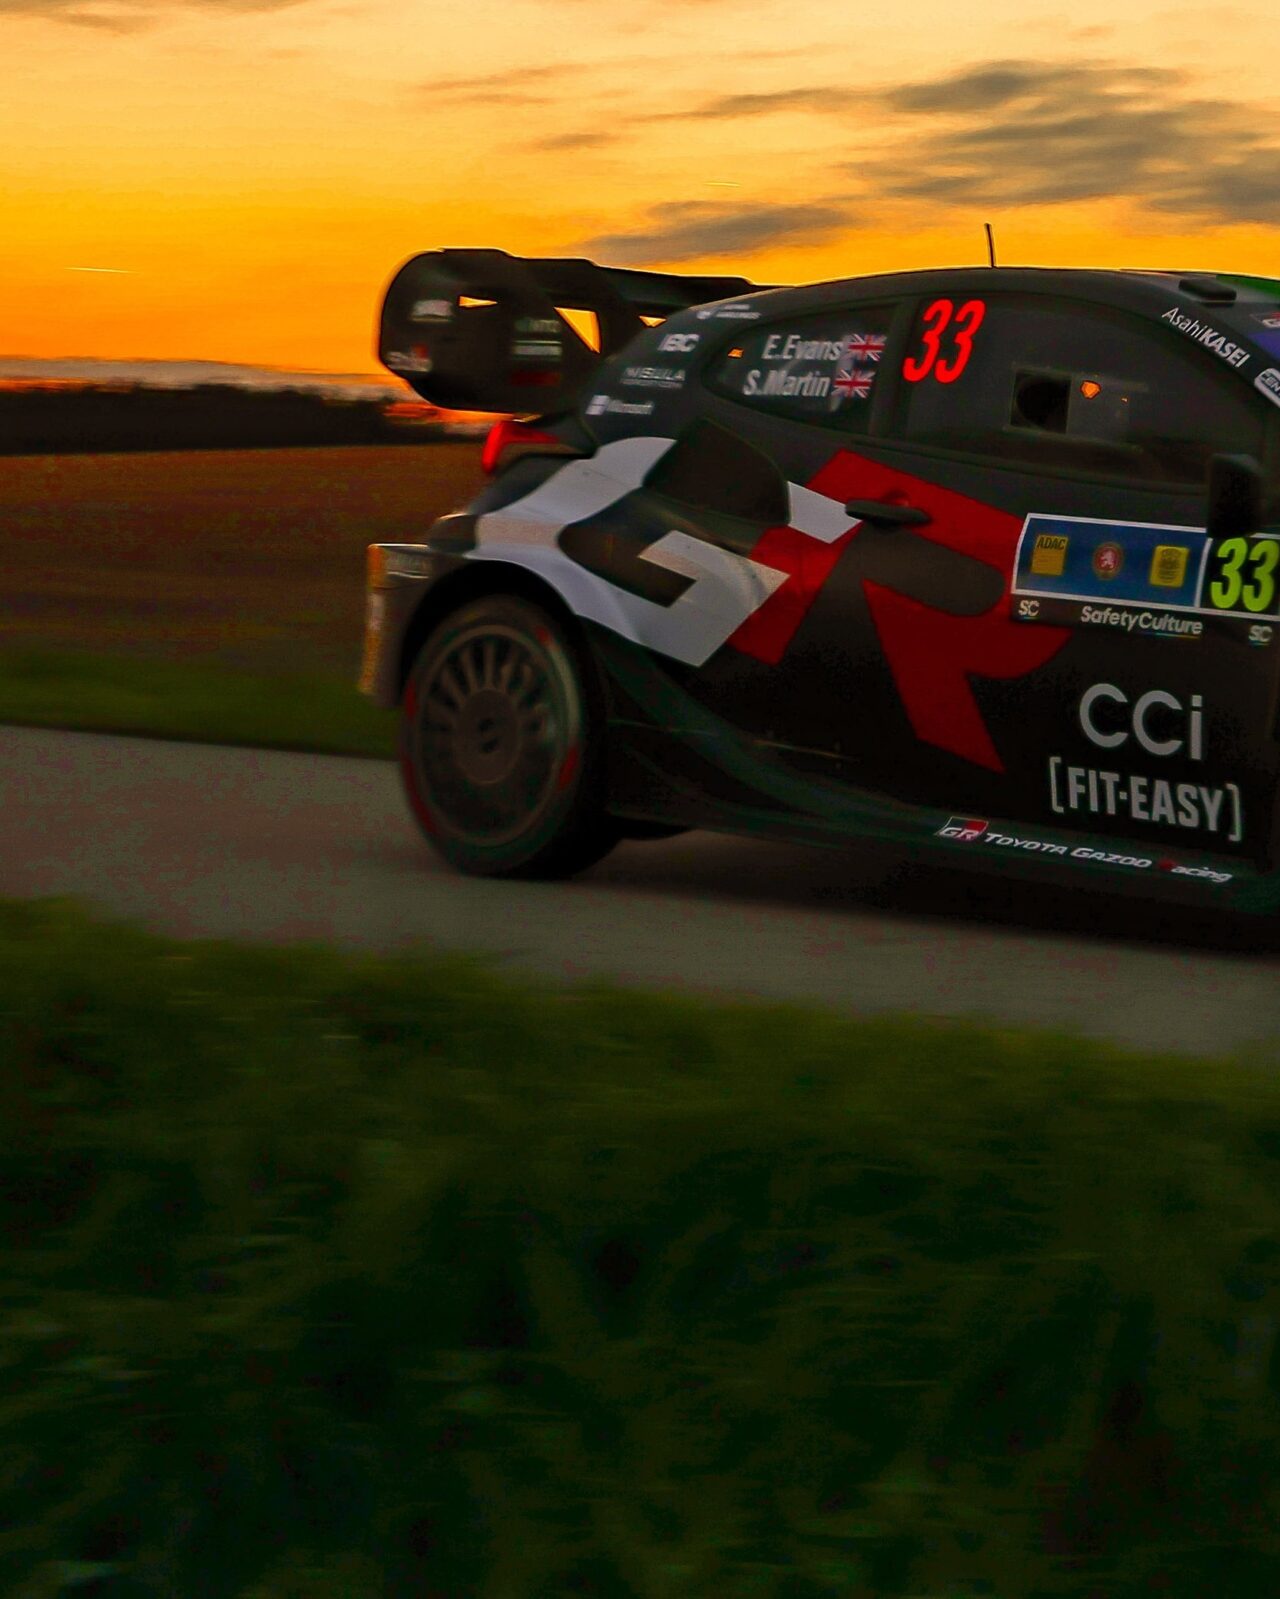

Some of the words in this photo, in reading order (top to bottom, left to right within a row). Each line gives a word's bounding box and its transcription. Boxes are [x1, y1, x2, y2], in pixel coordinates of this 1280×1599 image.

[761, 334, 843, 362] E.Evans
[901, 297, 986, 384] 33
[742, 369, 831, 397] S.Martin
[1209, 536, 1280, 613] 33
[1018, 599, 1040, 617] SC
[1080, 605, 1204, 635] SafetyCulture
[1249, 624, 1273, 643] SC
